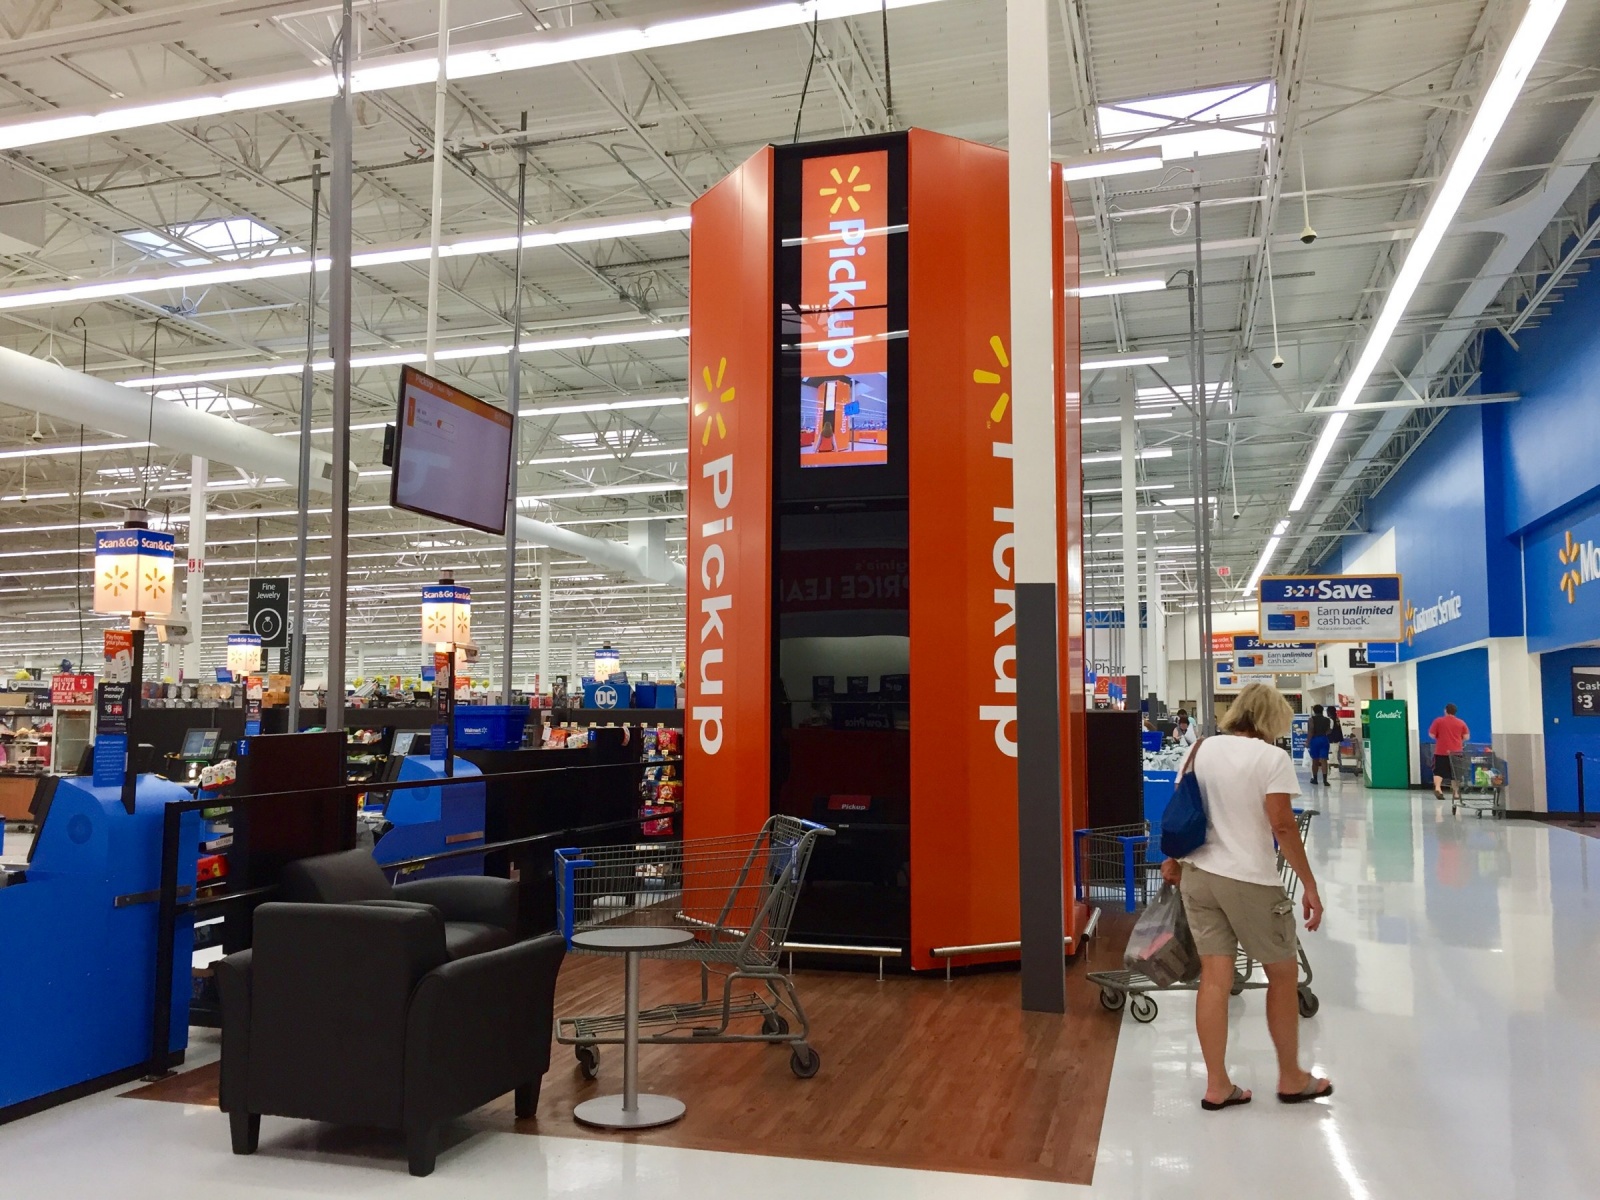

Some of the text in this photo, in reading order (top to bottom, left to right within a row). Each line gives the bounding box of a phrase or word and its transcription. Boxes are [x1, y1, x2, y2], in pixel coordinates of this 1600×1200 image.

[818, 219, 867, 367] Pickup
[99, 537, 139, 549] Scan&Go
[141, 537, 174, 552] Scan&Go
[261, 582, 276, 591] Fine
[1318, 580, 1373, 599] Save
[256, 591, 281, 601] Jewelry
[424, 590, 454, 599] Scan&Go
[693, 453, 733, 755] Pickup
[1317, 605, 1394, 616] Earn unlimited
[1413, 590, 1462, 634] Customer Service
[1317, 615, 1340, 626] cash
[53, 682, 75, 691] PIZZA
[80, 678, 88, 689] $5
[104, 685, 125, 693] Sending
[1576, 681, 1600, 691] Cash
[103, 693, 124, 701] money?
[596, 690, 616, 705] DC
[841, 803, 866, 811] Pickup
